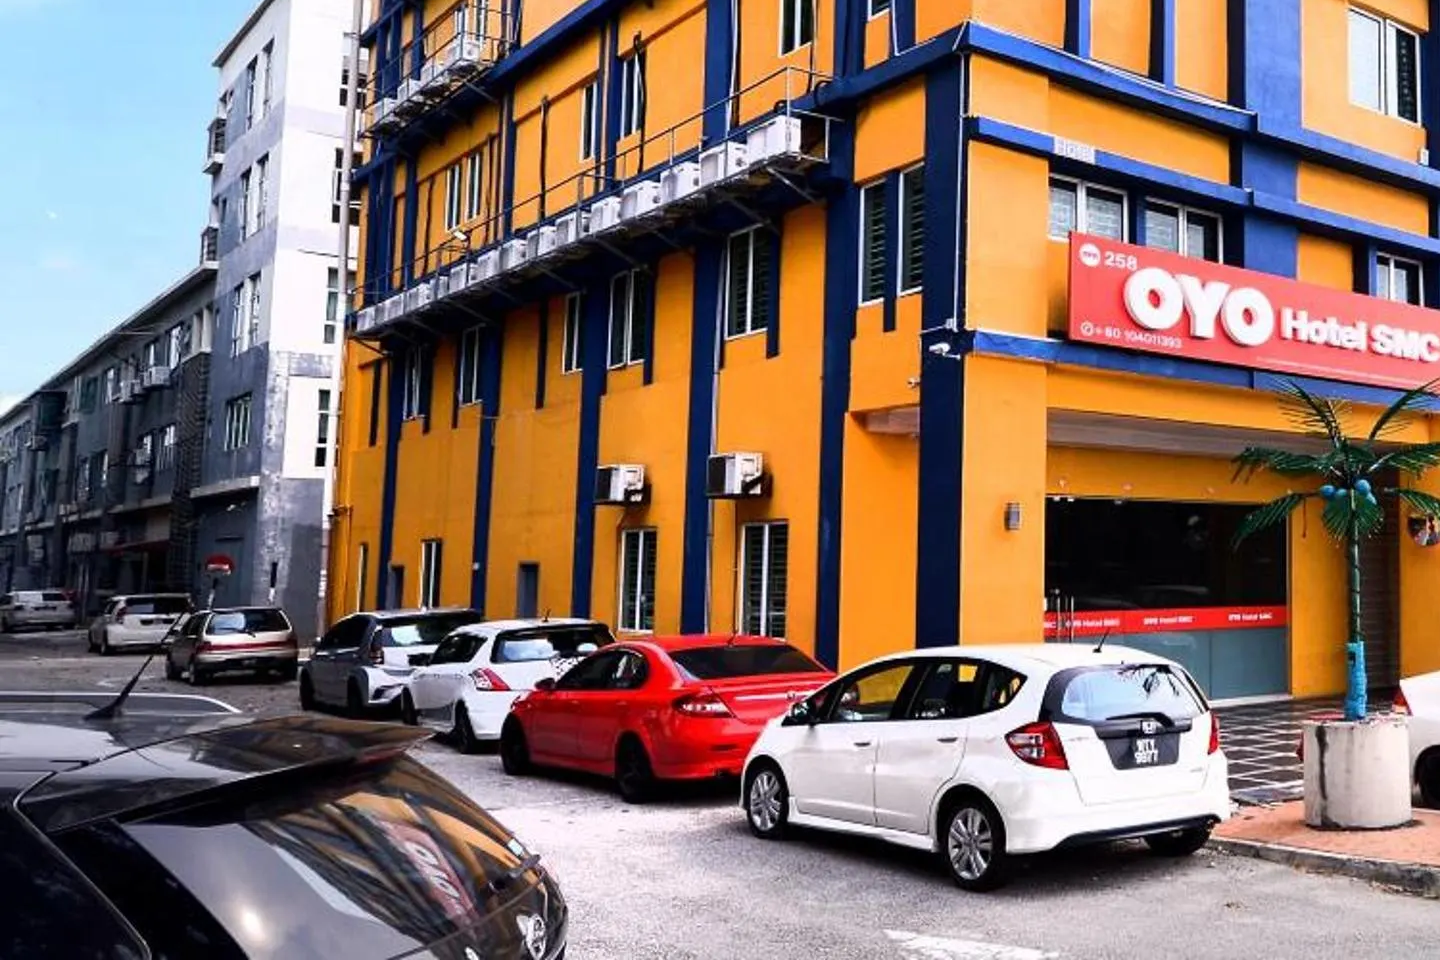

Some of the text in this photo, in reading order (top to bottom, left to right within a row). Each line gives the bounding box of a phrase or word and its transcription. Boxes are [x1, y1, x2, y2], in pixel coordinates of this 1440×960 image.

[1104, 250, 1138, 271] 258
[1123, 267, 1275, 346] OYO
[1280, 306, 1369, 352] Hotel
